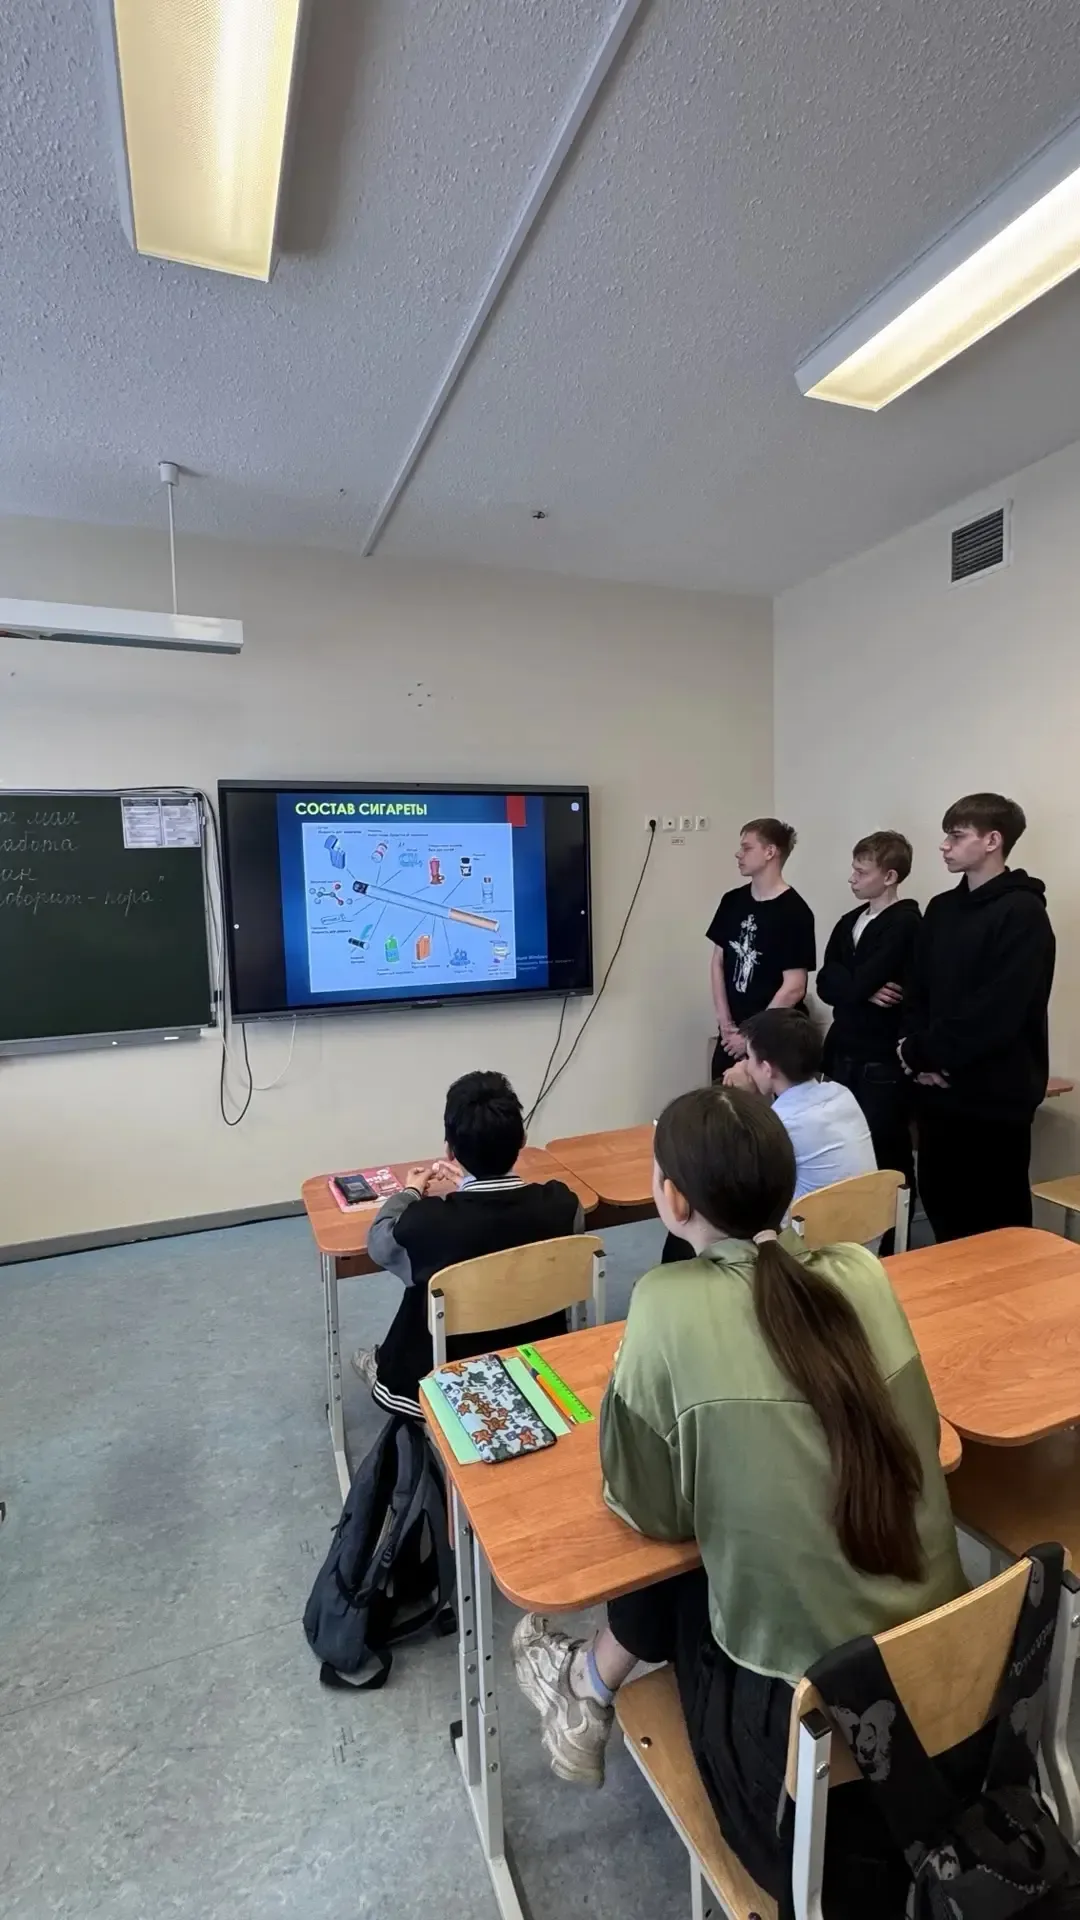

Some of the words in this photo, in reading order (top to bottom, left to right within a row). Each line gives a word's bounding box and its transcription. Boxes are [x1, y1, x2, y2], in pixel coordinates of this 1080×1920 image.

[295, 802, 356, 815] СОСТАВ
[358, 803, 428, 816] СИГАРЕТЫ
[26, 811, 82, 826] мая
[0, 830, 81, 850] абота
[0, 884, 83, 916] оворит
